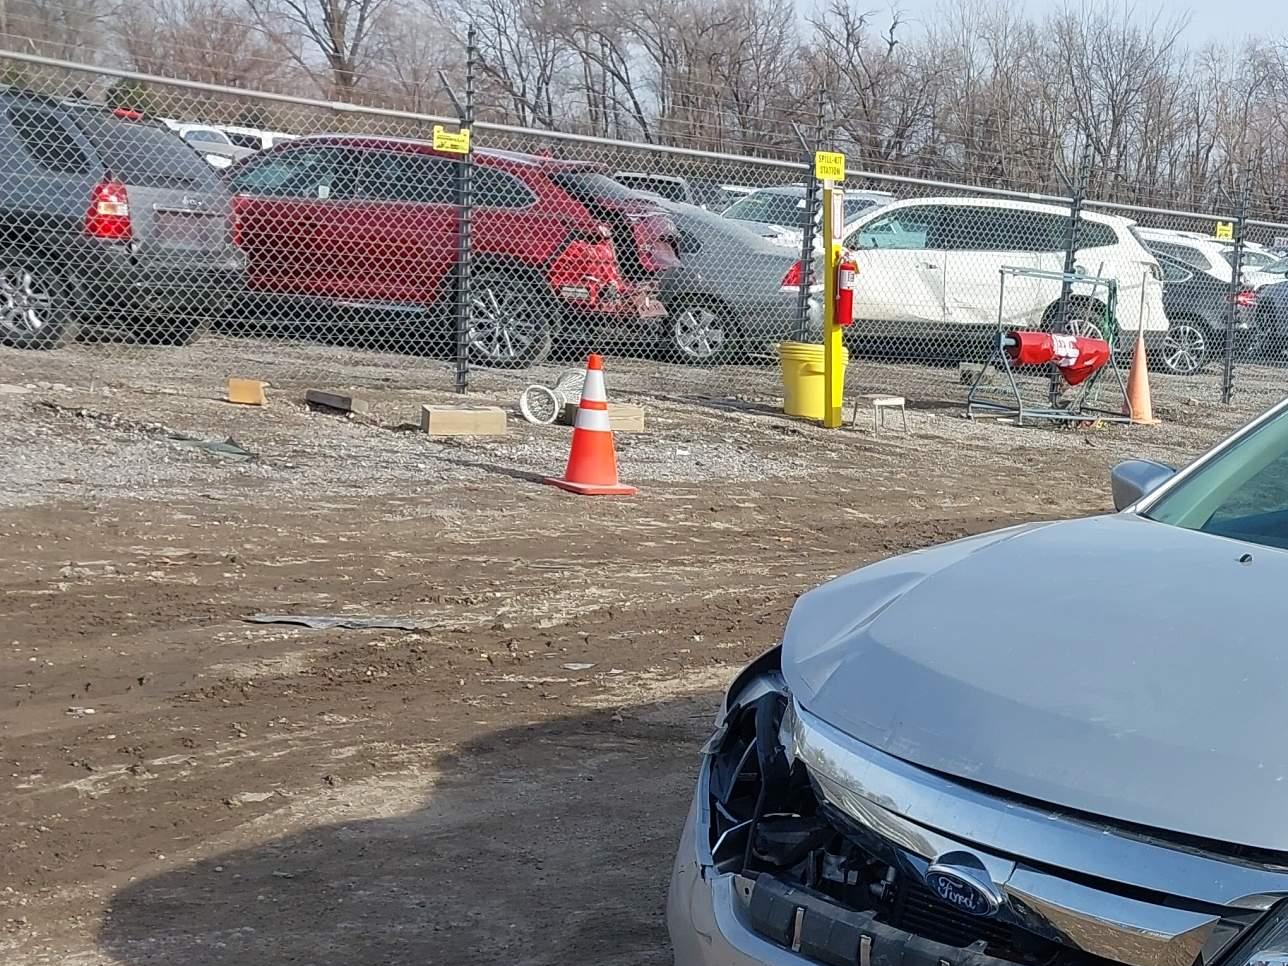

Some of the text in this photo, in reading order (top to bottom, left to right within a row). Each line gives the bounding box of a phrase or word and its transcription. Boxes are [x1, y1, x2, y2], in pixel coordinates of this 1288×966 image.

[818, 154, 842, 164] SPILL-KIT
[820, 166, 841, 176] STATION
[938, 876, 976, 910] Ford
